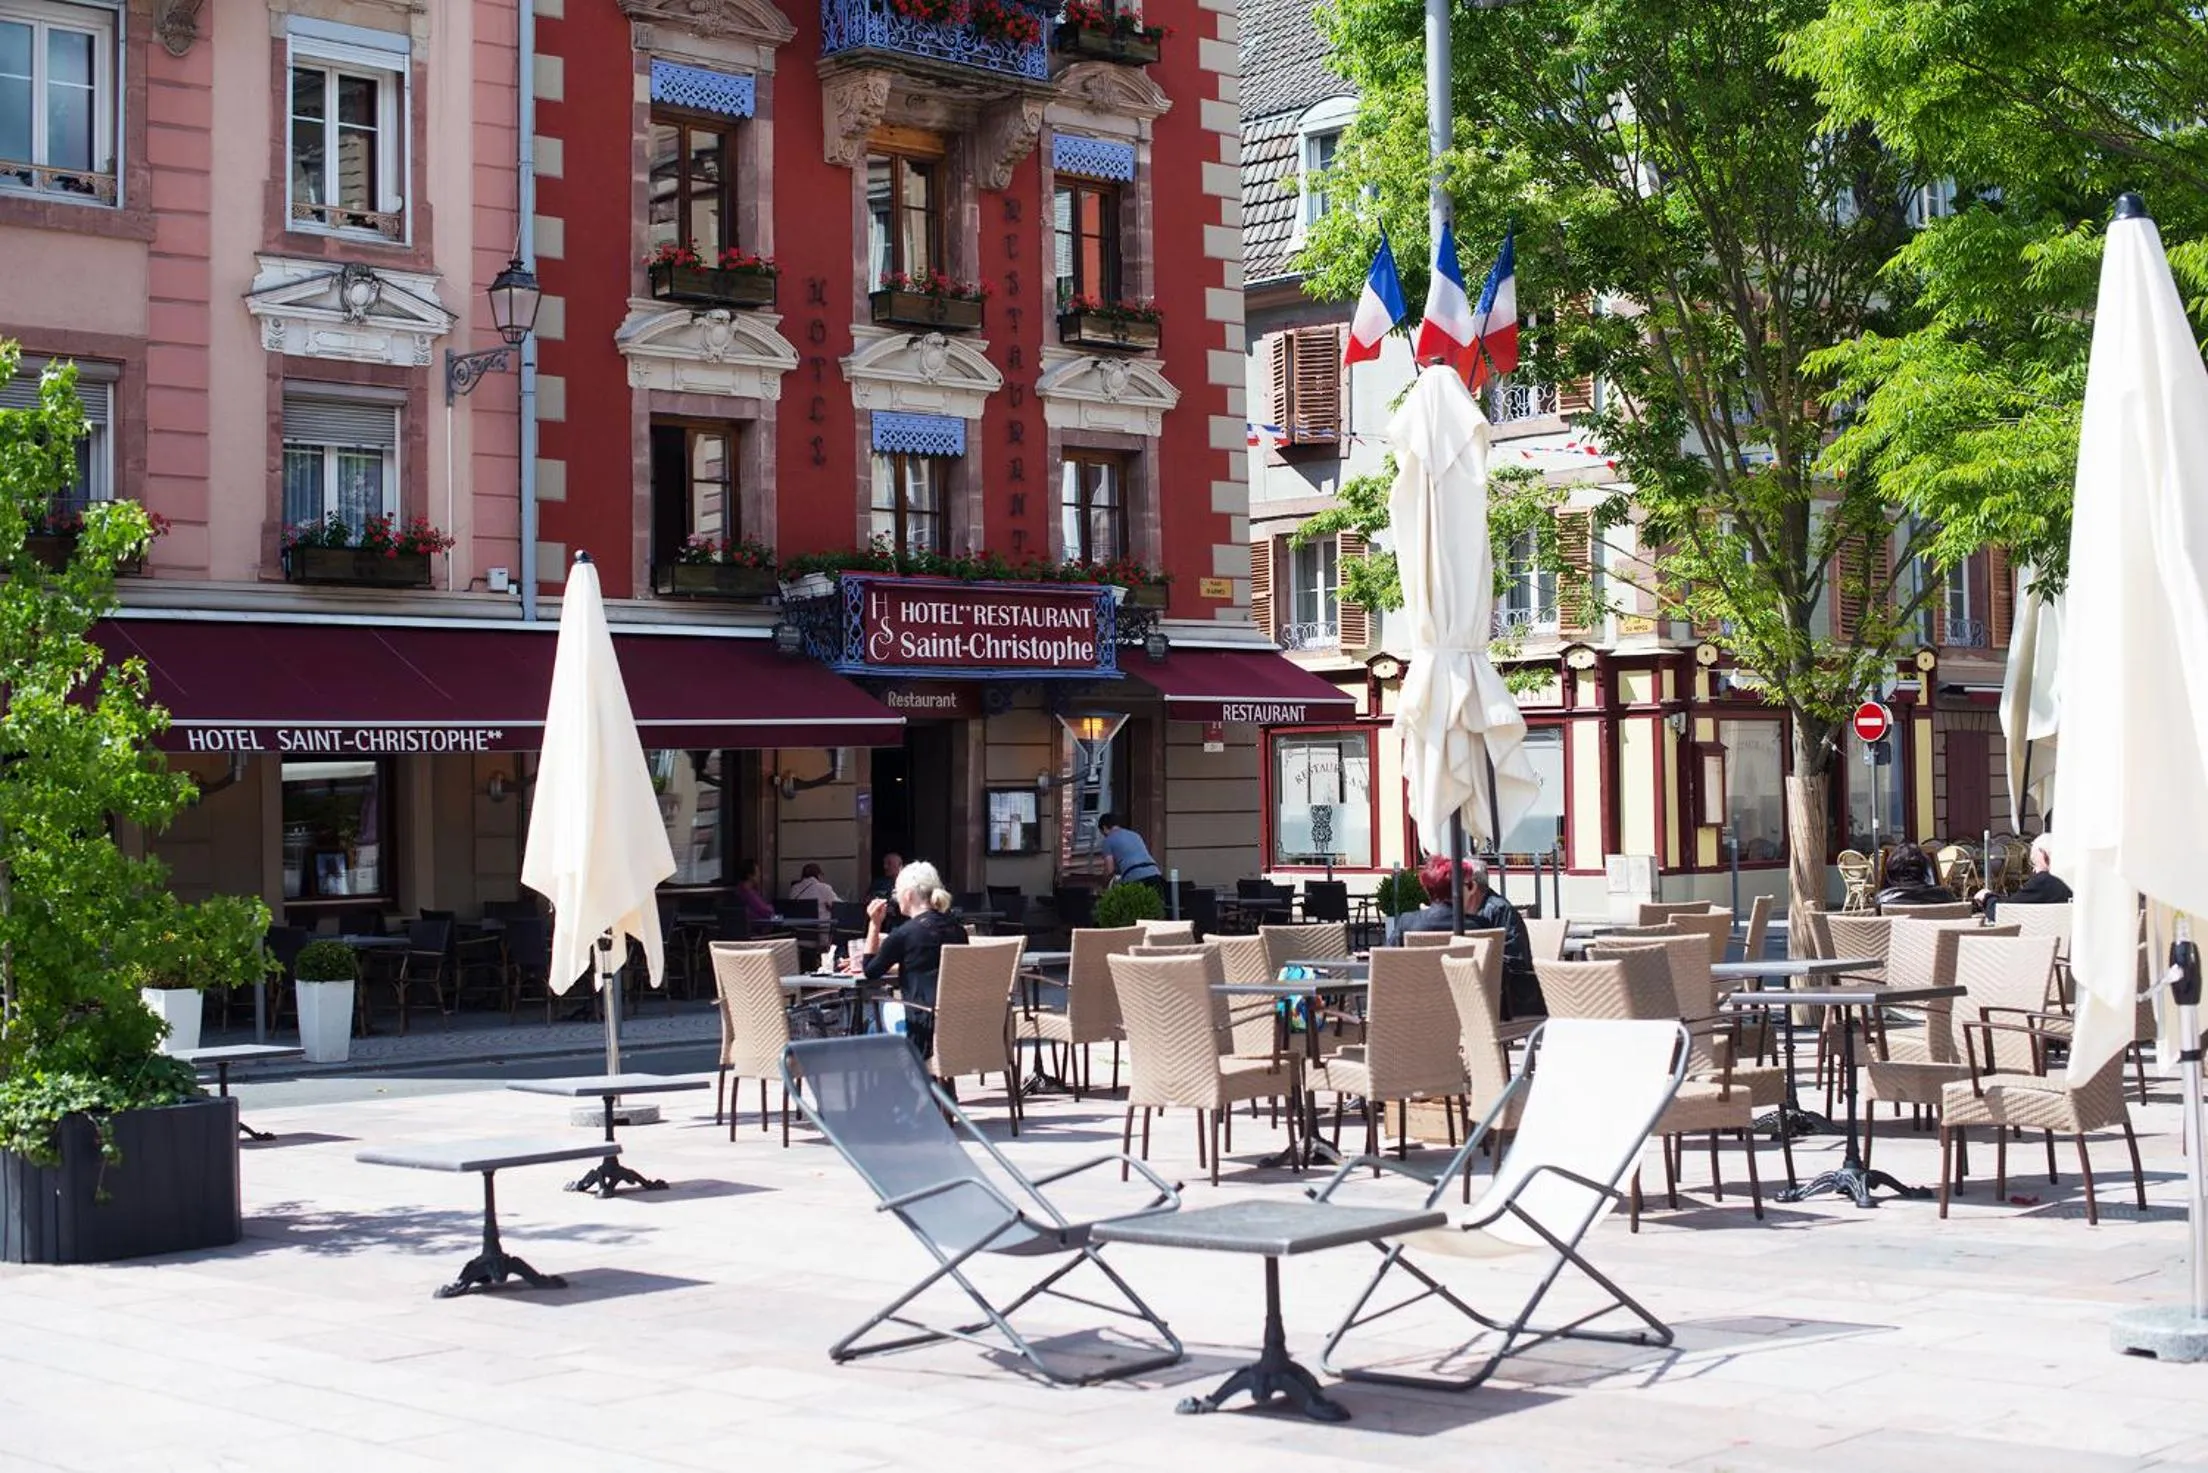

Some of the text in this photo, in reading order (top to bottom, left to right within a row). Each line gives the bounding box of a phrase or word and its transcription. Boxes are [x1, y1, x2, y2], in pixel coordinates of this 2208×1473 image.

[1005, 198, 1028, 553] RESTAURANT
[974, 605, 1092, 628] RESTAURANT
[900, 631, 1094, 665] Saint-Christophe
[888, 690, 957, 707] Restaurant
[1222, 704, 1307, 721] RESTAURANT
[187, 729, 265, 751] HOTEL
